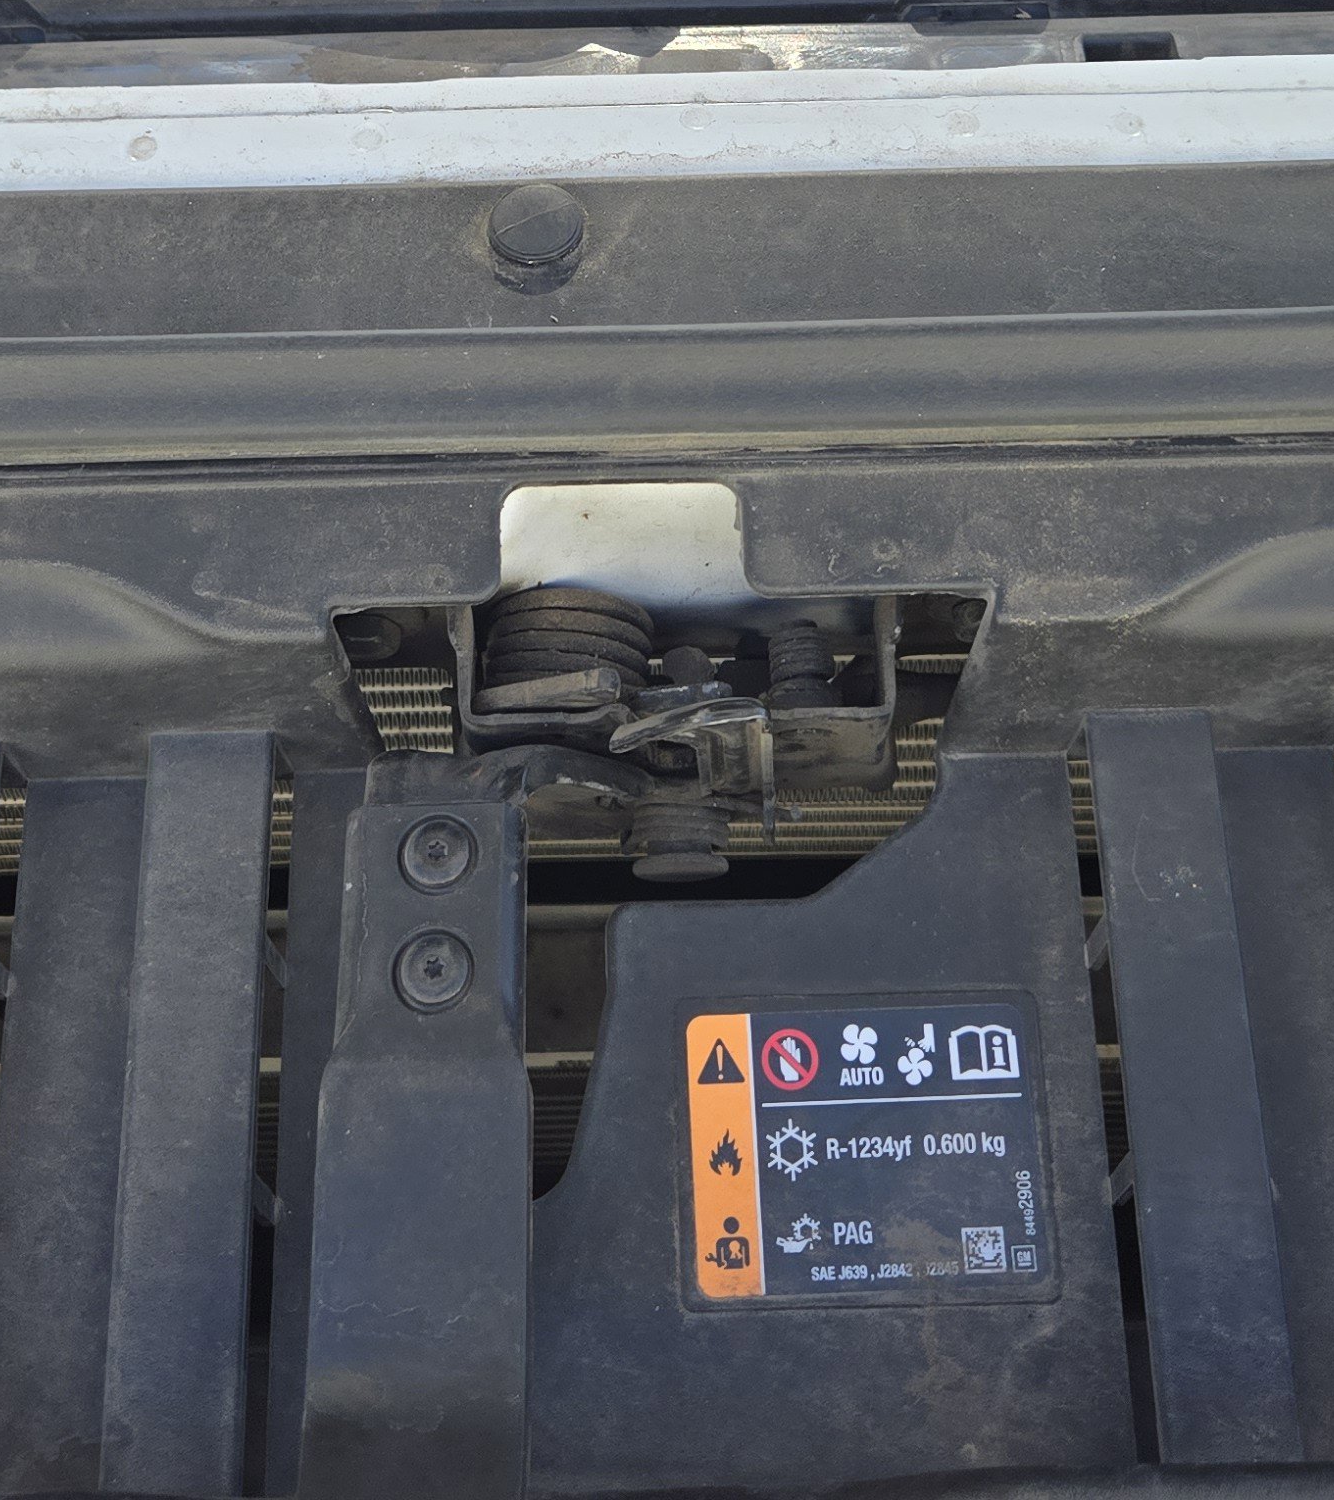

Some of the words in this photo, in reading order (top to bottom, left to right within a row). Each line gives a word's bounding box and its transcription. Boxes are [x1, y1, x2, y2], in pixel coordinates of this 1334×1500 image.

[839, 1066, 885, 1087] AUTO
[825, 1134, 912, 1162] R-1234yf
[923, 1132, 977, 1156] 0.600
[981, 1131, 1006, 1158] kg
[1015, 1170, 1036, 1236] 84492906
[833, 1221, 874, 1246] PAG
[810, 1266, 836, 1282] SAE
